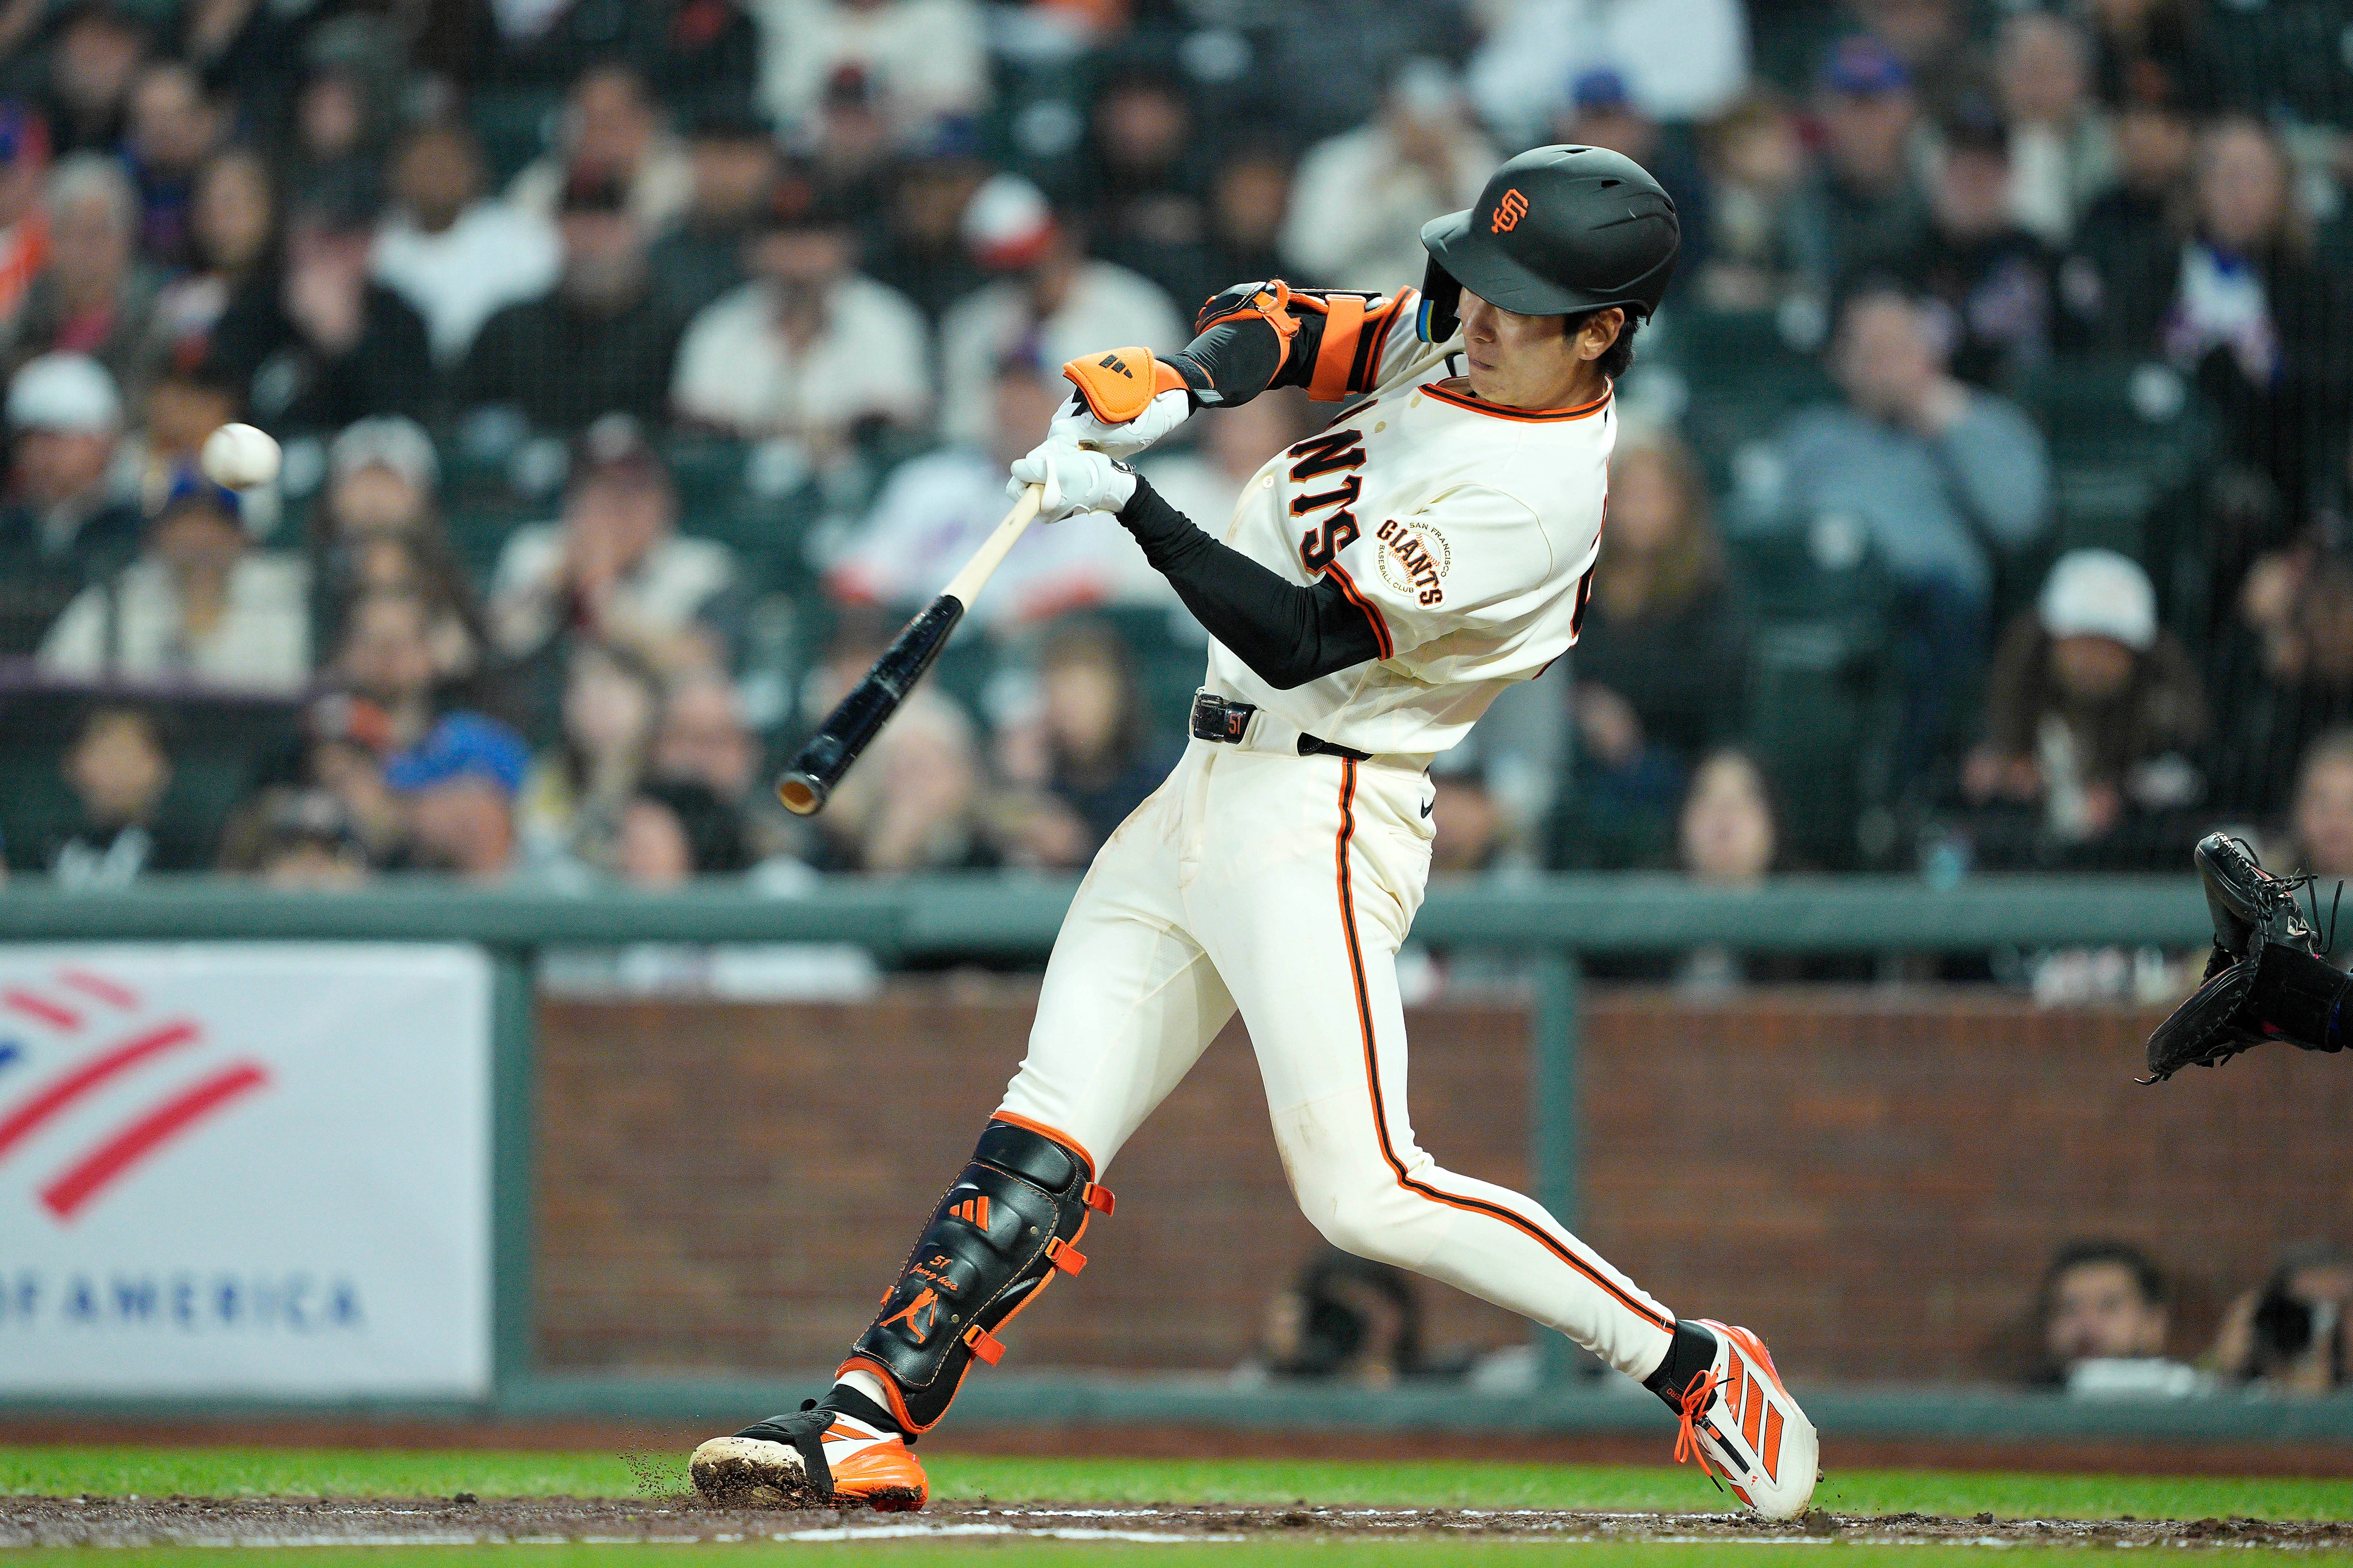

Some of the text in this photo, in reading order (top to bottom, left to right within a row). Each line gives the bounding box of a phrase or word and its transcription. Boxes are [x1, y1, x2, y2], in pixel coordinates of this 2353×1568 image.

[1491, 188, 1529, 234] SF
[1287, 399, 1378, 577] NTS
[1376, 519, 1443, 606] GIANTS
[1378, 544, 1414, 593] BASEBALL CLUB
[1431, 527, 1451, 578] FRANCISCO
[1228, 712, 1241, 735] 51
[929, 1255, 951, 1269] 51
[65, 1269, 367, 1332] AMERICA
